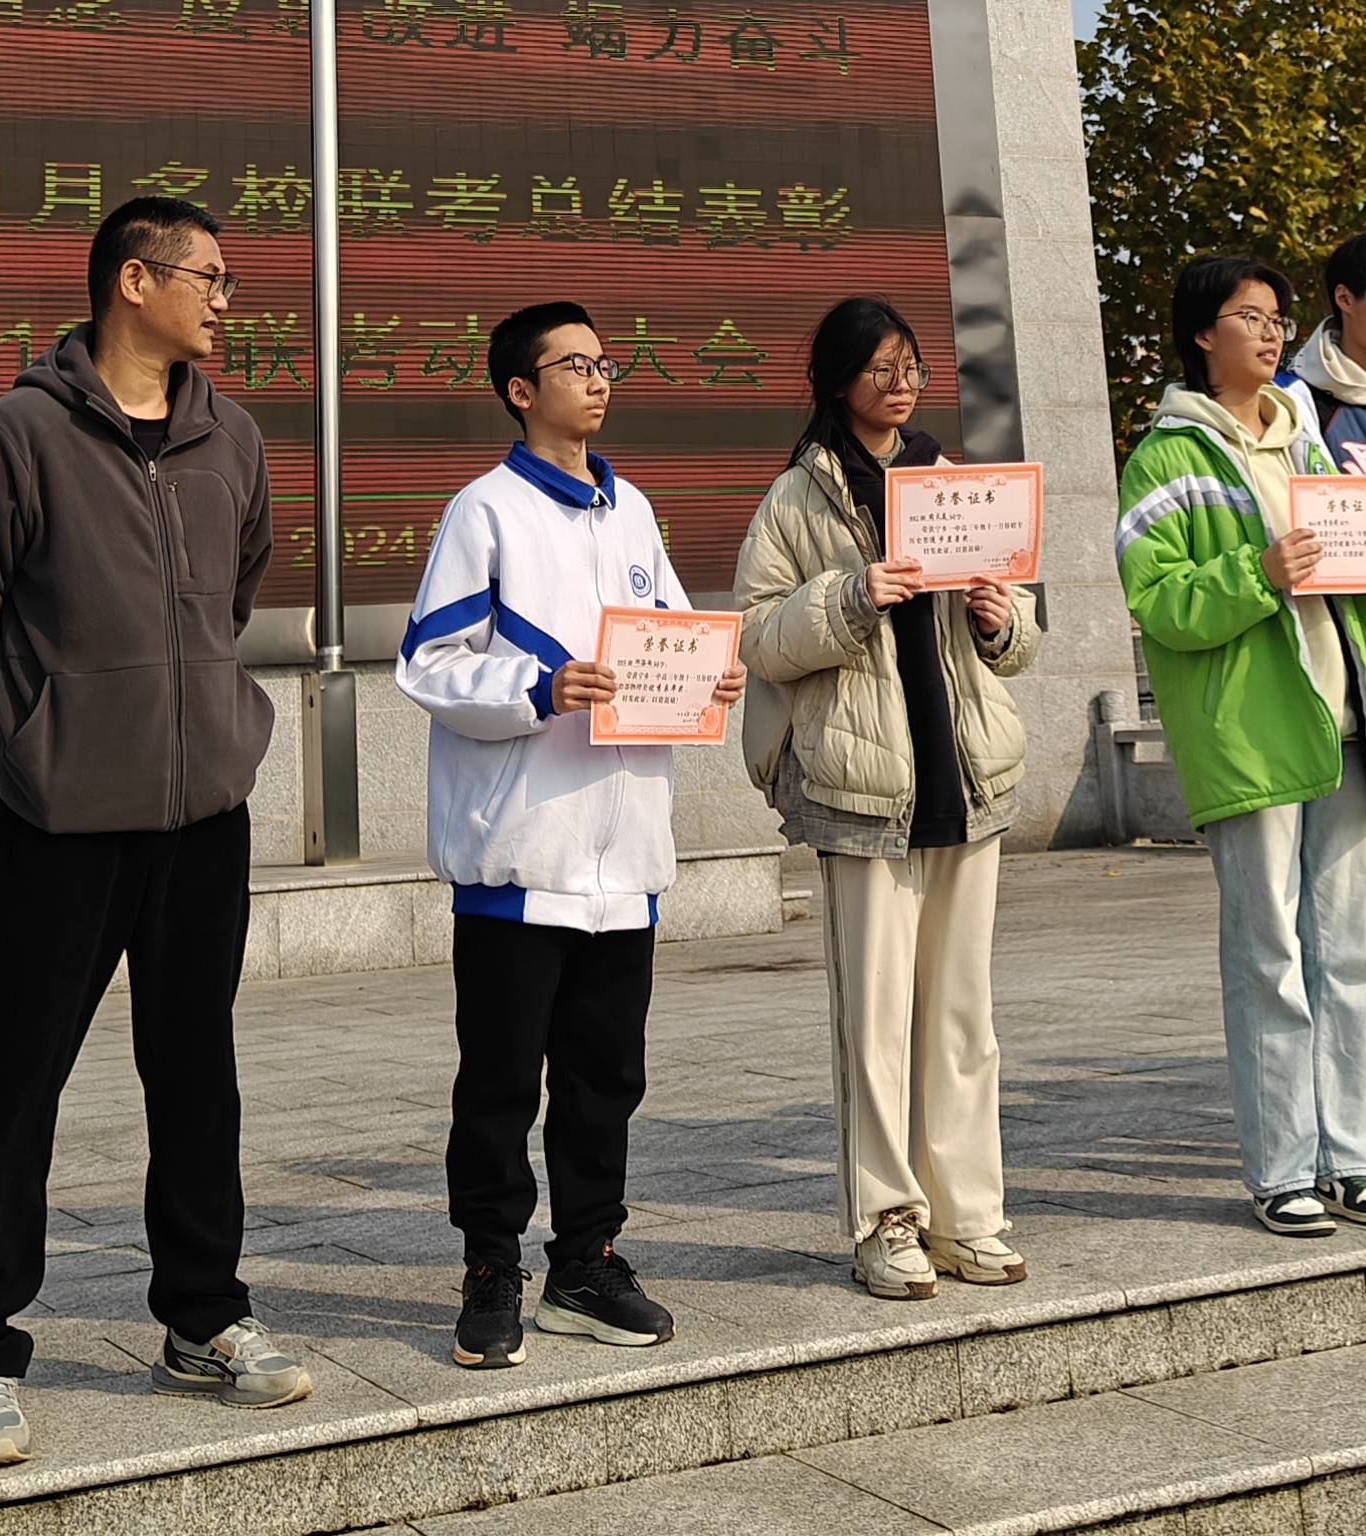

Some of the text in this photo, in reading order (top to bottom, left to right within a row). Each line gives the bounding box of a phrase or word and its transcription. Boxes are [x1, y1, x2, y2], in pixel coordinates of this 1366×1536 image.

[934, 489, 996, 506] 荣誉证书
[643, 636, 700, 654] 荣誉证书
